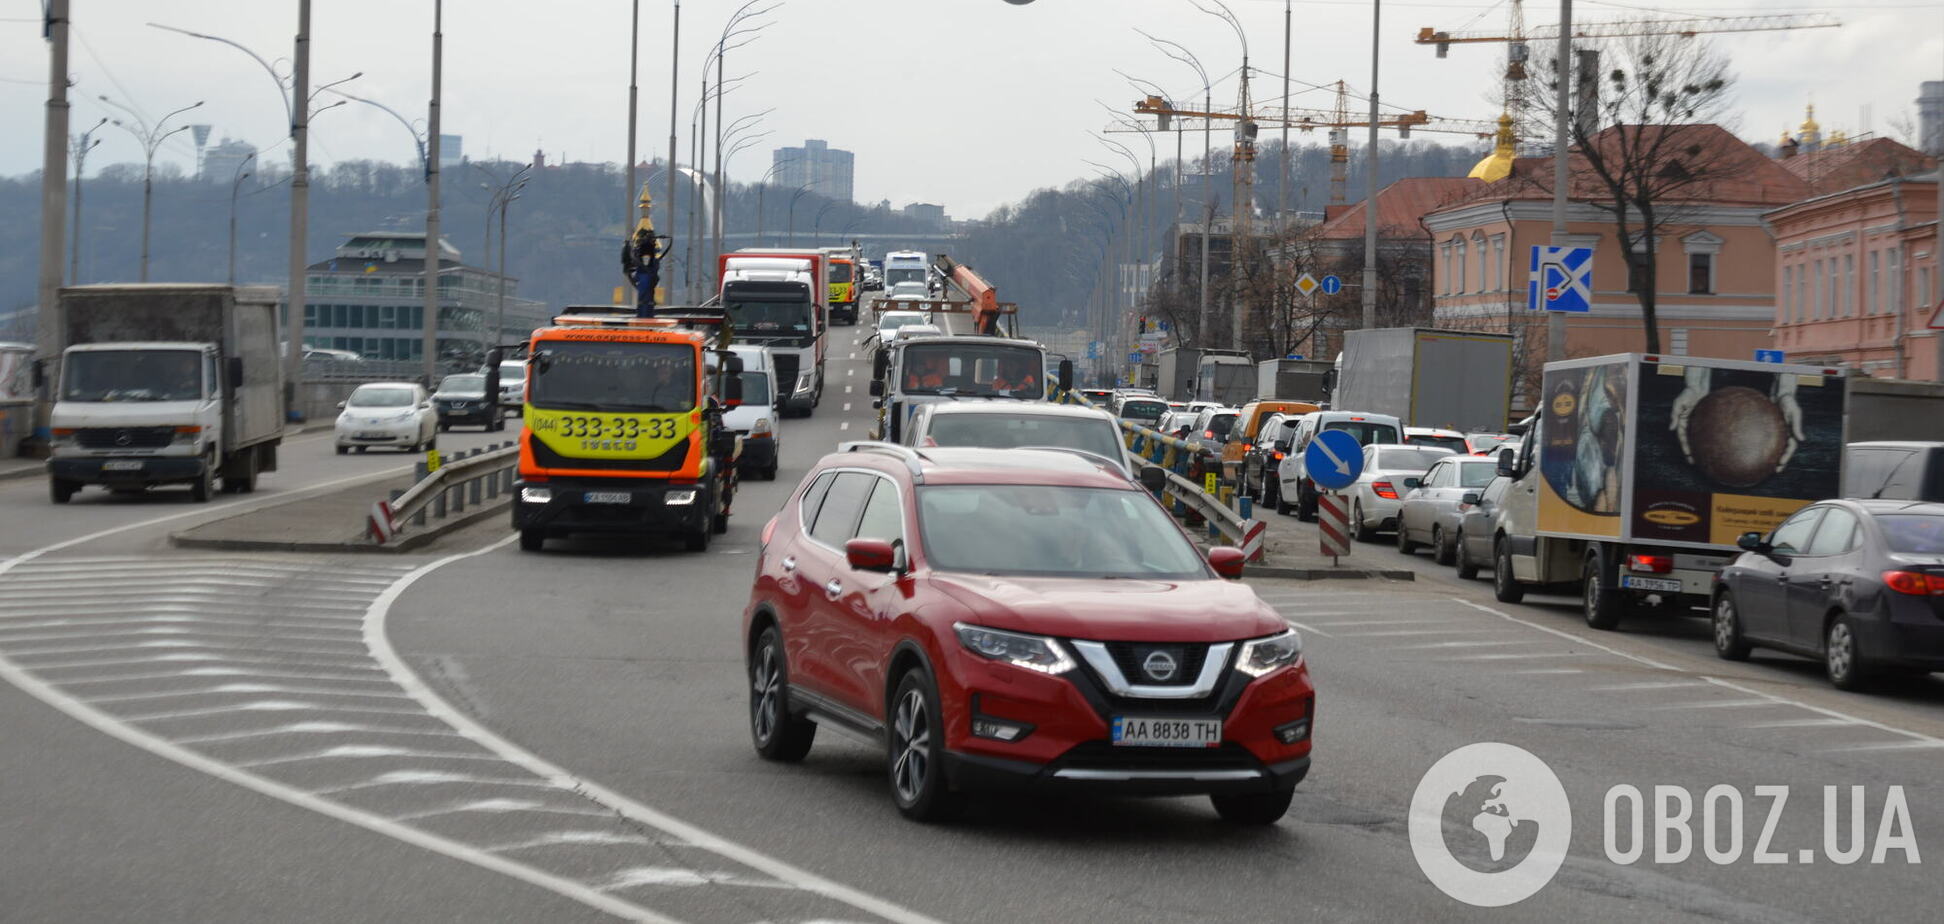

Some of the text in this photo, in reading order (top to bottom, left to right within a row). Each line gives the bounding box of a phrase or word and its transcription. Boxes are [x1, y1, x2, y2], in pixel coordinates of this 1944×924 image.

[560, 416, 677, 439] 333-33-33
[581, 440, 637, 451] IVECO
[1125, 721, 1218, 741] AA 8838 TH
